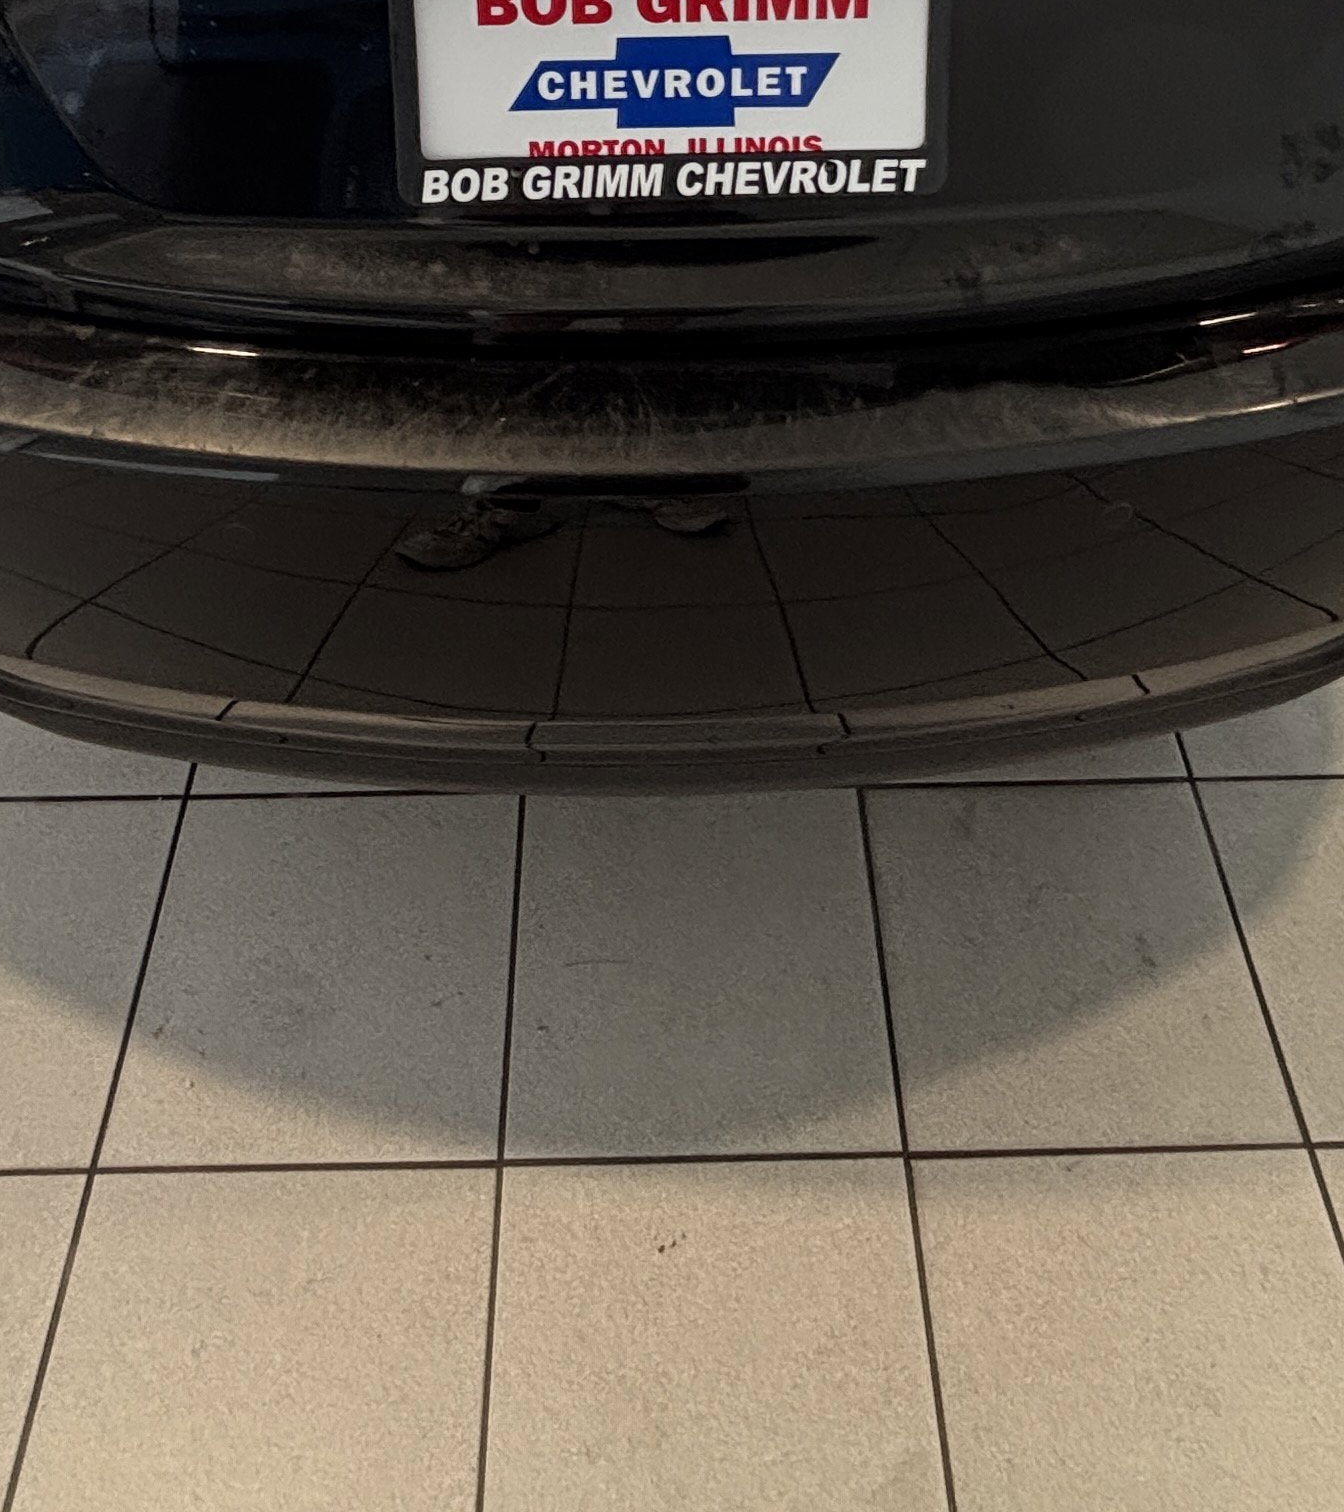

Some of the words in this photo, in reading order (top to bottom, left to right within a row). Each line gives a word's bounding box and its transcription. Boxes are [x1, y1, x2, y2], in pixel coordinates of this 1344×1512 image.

[537, 65, 809, 102] CHEVROLET
[421, 167, 509, 204] BOB
[522, 163, 664, 200] GRIMM
[676, 158, 927, 196] CHEVROLET
